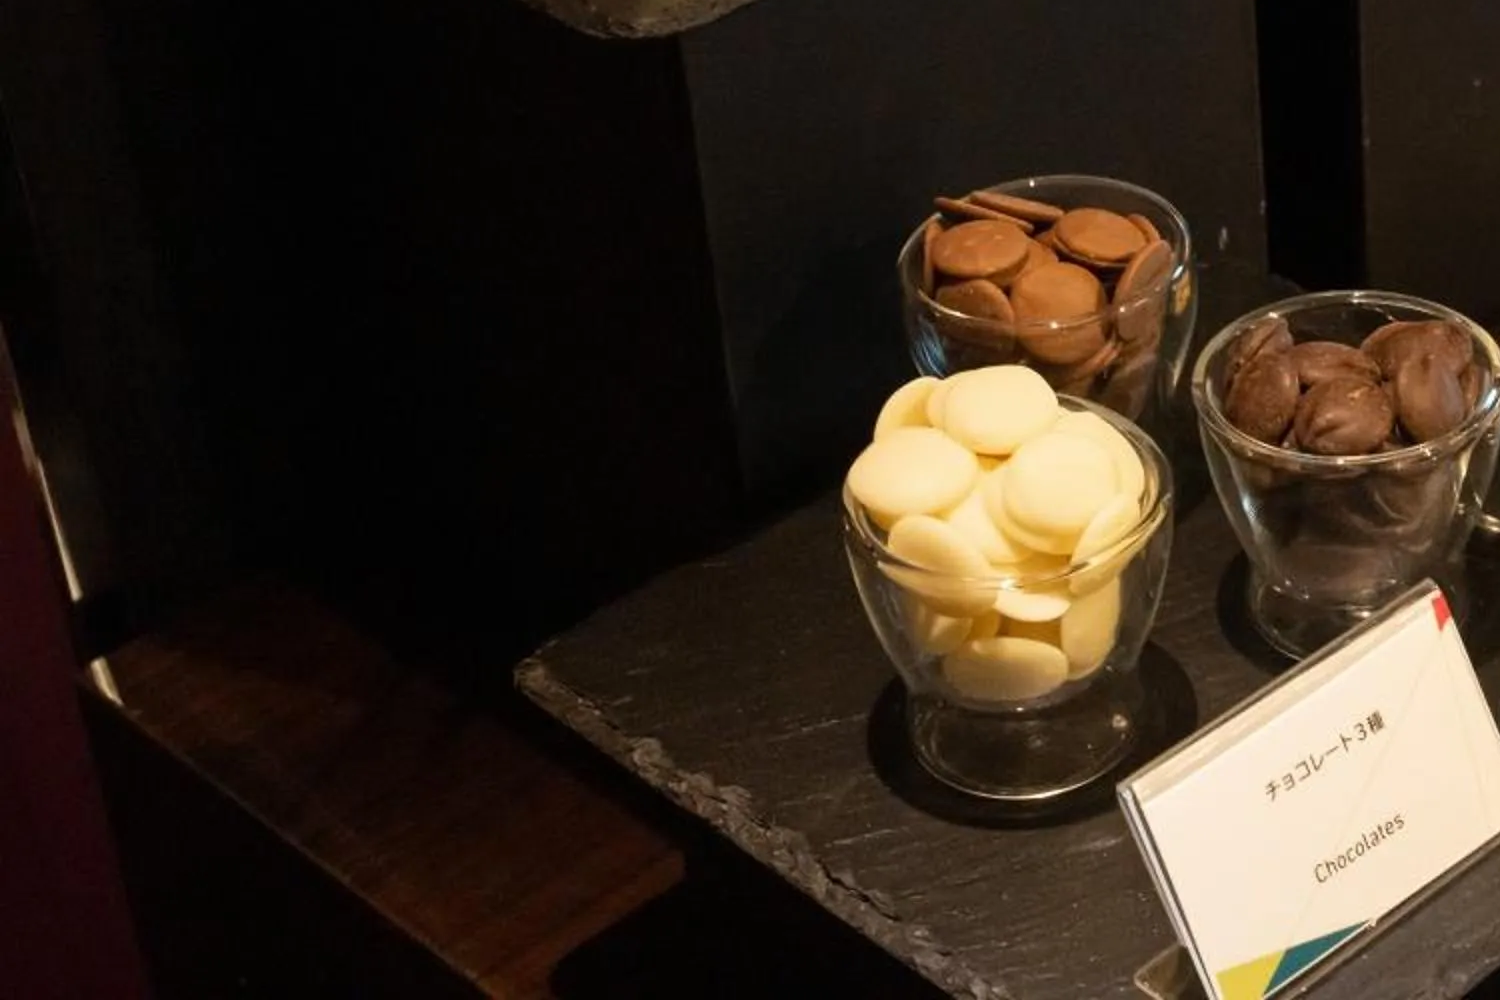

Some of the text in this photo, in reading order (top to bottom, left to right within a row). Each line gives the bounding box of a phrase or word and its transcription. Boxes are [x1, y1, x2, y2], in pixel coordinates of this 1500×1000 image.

[1265, 709, 1385, 801] チョコレート3種
[1313, 813, 1405, 884] Chocolates
